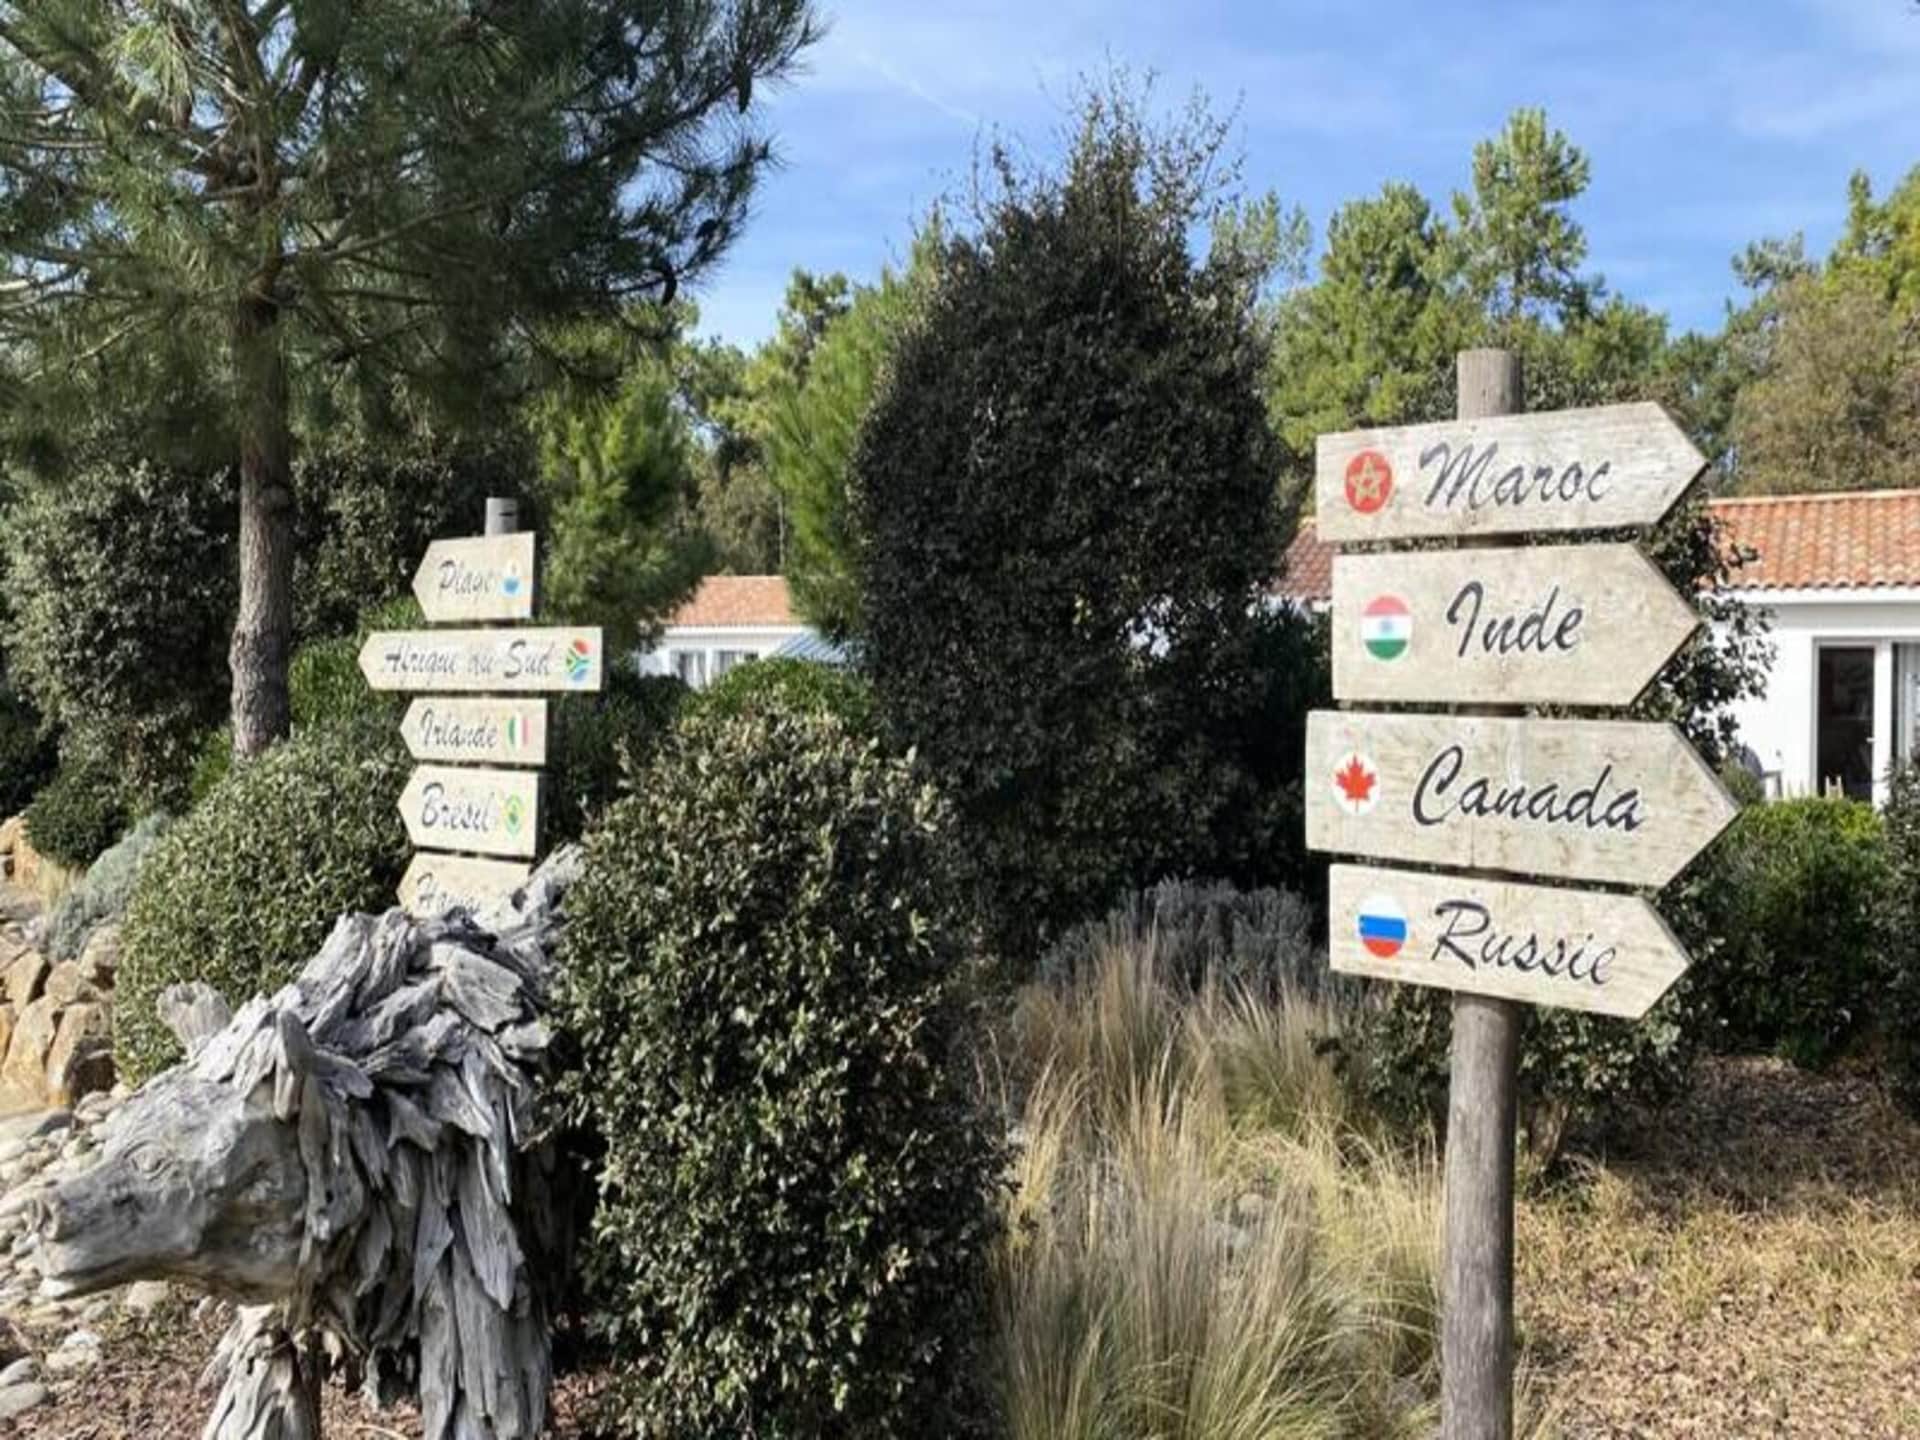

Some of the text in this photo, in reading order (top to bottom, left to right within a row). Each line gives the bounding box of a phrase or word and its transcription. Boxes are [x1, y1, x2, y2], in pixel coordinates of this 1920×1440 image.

[1418, 440, 1612, 511] Maroc
[1446, 580, 1584, 657] Inde
[503, 639, 556, 679] Sud
[420, 707, 498, 749] Irlande
[1412, 745, 1645, 832] Canada
[1431, 900, 1617, 985] Russie
